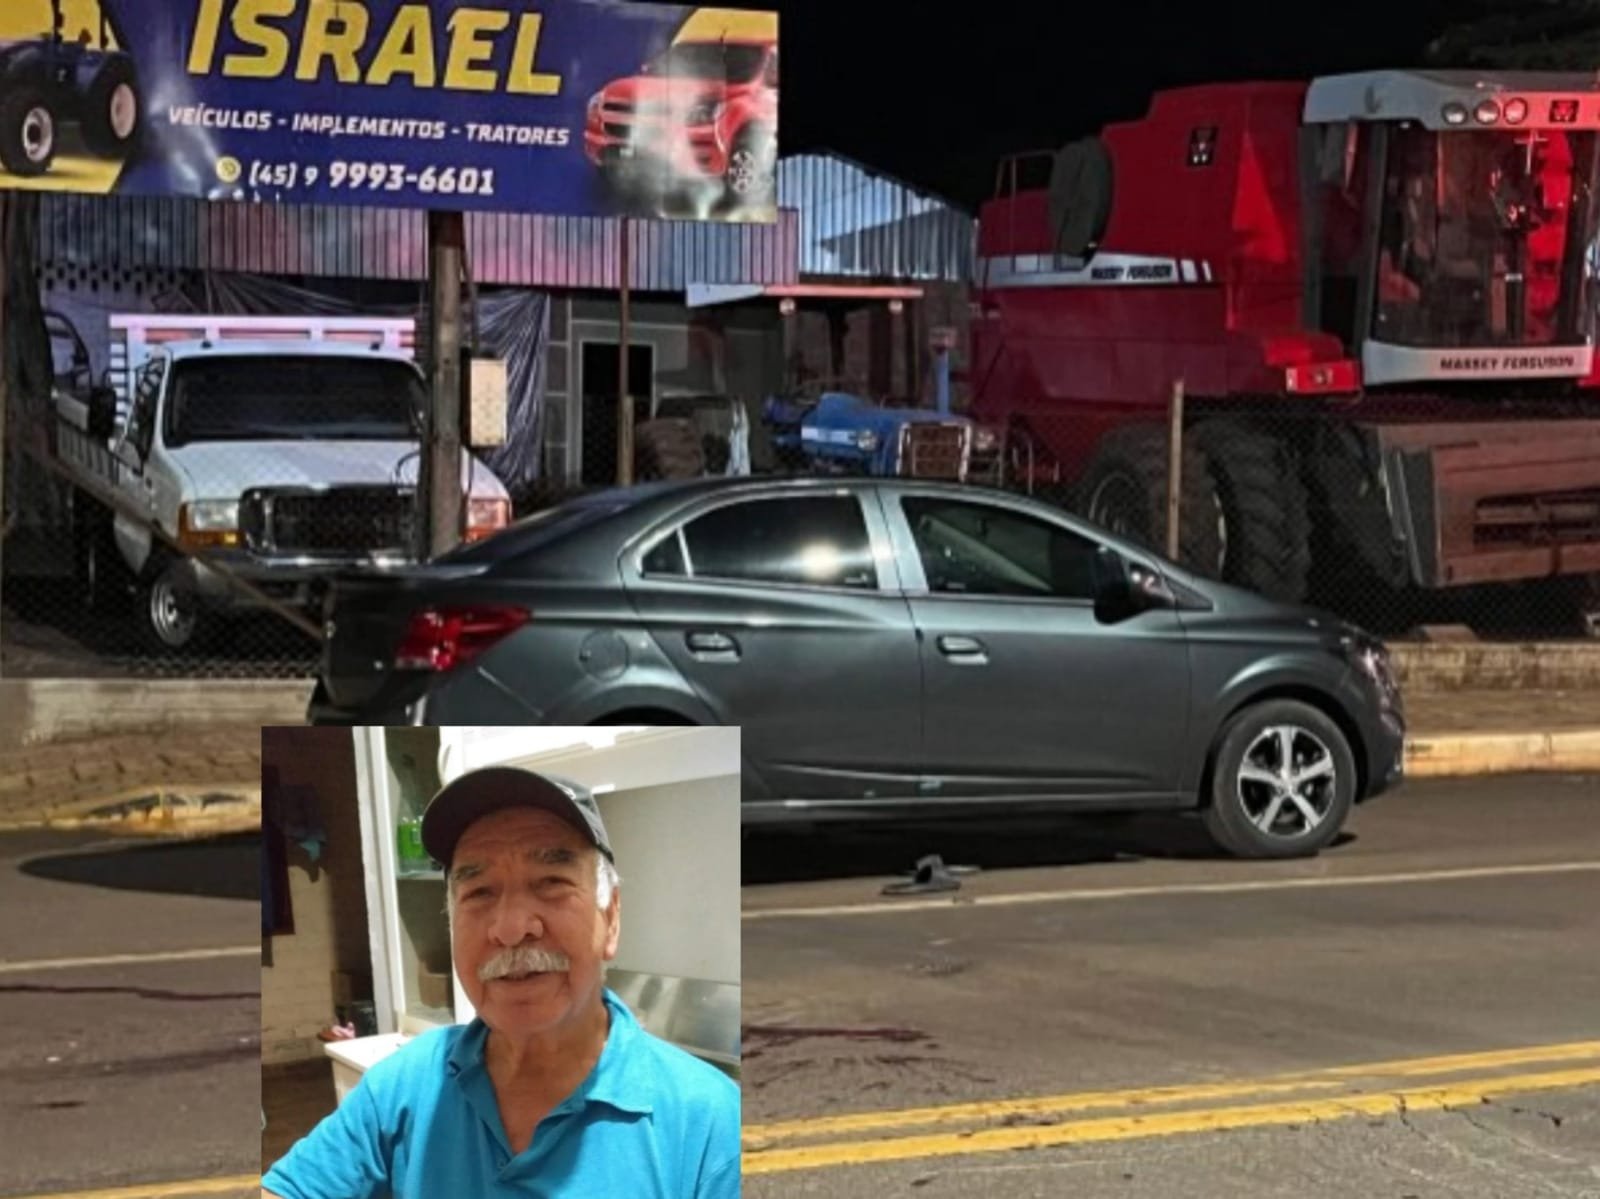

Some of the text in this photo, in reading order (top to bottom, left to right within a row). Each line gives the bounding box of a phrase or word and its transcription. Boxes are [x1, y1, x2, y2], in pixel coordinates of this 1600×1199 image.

[187, 0, 562, 95] ISRAEL
[169, 102, 273, 131] VEÍCULOS
[292, 113, 447, 139] IMPLEMENTOS
[465, 123, 570, 146] TRATORES
[249, 159, 495, 195] (45) 9 9993-6601
[1440, 355, 1575, 371] MASSEY FERGUSON
